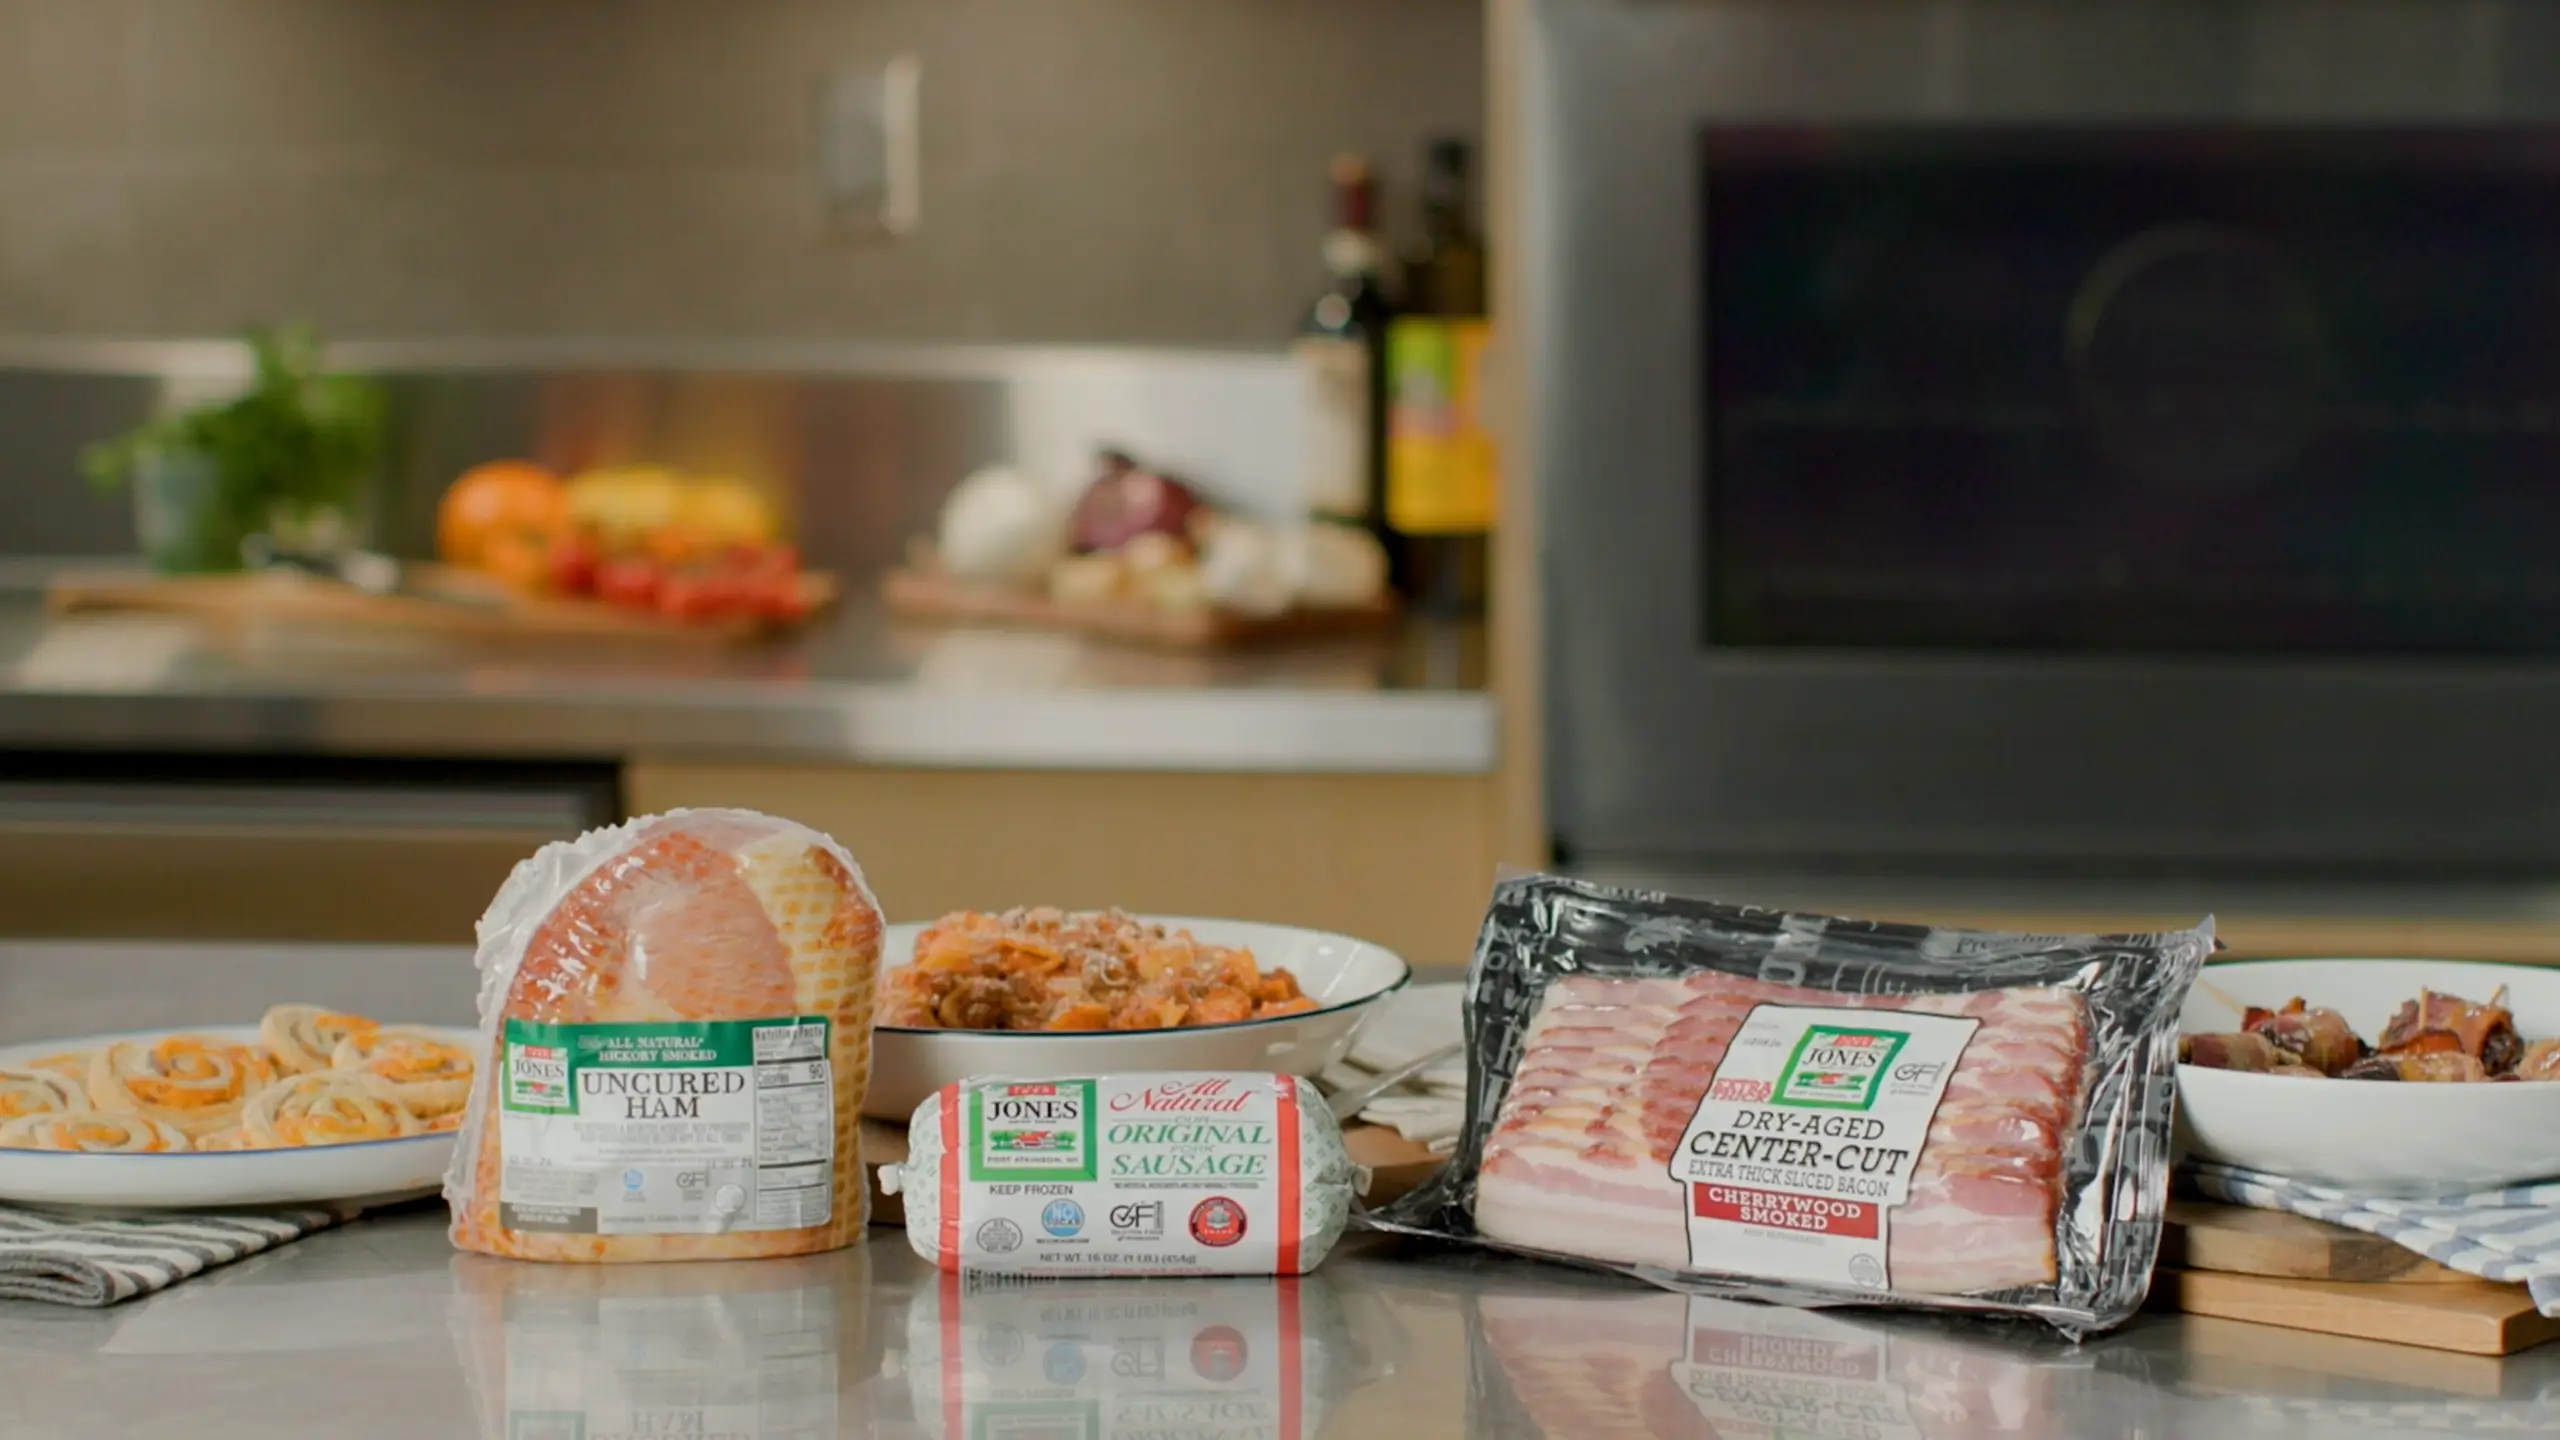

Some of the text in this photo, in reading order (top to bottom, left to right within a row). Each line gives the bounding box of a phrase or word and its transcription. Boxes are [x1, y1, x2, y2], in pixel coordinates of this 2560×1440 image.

[608, 1038, 633, 1050] ALL
[599, 1049, 717, 1062] HICKORY SMOKED
[1802, 1047, 1880, 1068] JONES
[512, 1058, 566, 1078] JONES
[809, 1064, 824, 1080] 90
[582, 1071, 745, 1096] UNCURED
[1160, 1078, 1232, 1097] All
[625, 1096, 700, 1119] HAM
[986, 1100, 1079, 1122] JONES
[1110, 1088, 1254, 1113] Natural
[1108, 1124, 1273, 1145] ORIGINAL
[1732, 1109, 1886, 1141] DRY-AGED
[1690, 1130, 1908, 1176] CENTER-CUT
[1110, 1153, 1268, 1176] SAUSAGE
[1688, 1159, 1890, 1198] EXTRA THICK SLICED BACON
[989, 1184, 1074, 1196] KEEP FROZEN
[1708, 1186, 1862, 1219] CHERRYWOOD
[1739, 1206, 1829, 1231] SMOKED
[1040, 1253, 1061, 1263] NET
[1088, 1253, 1101, 1263] 16
